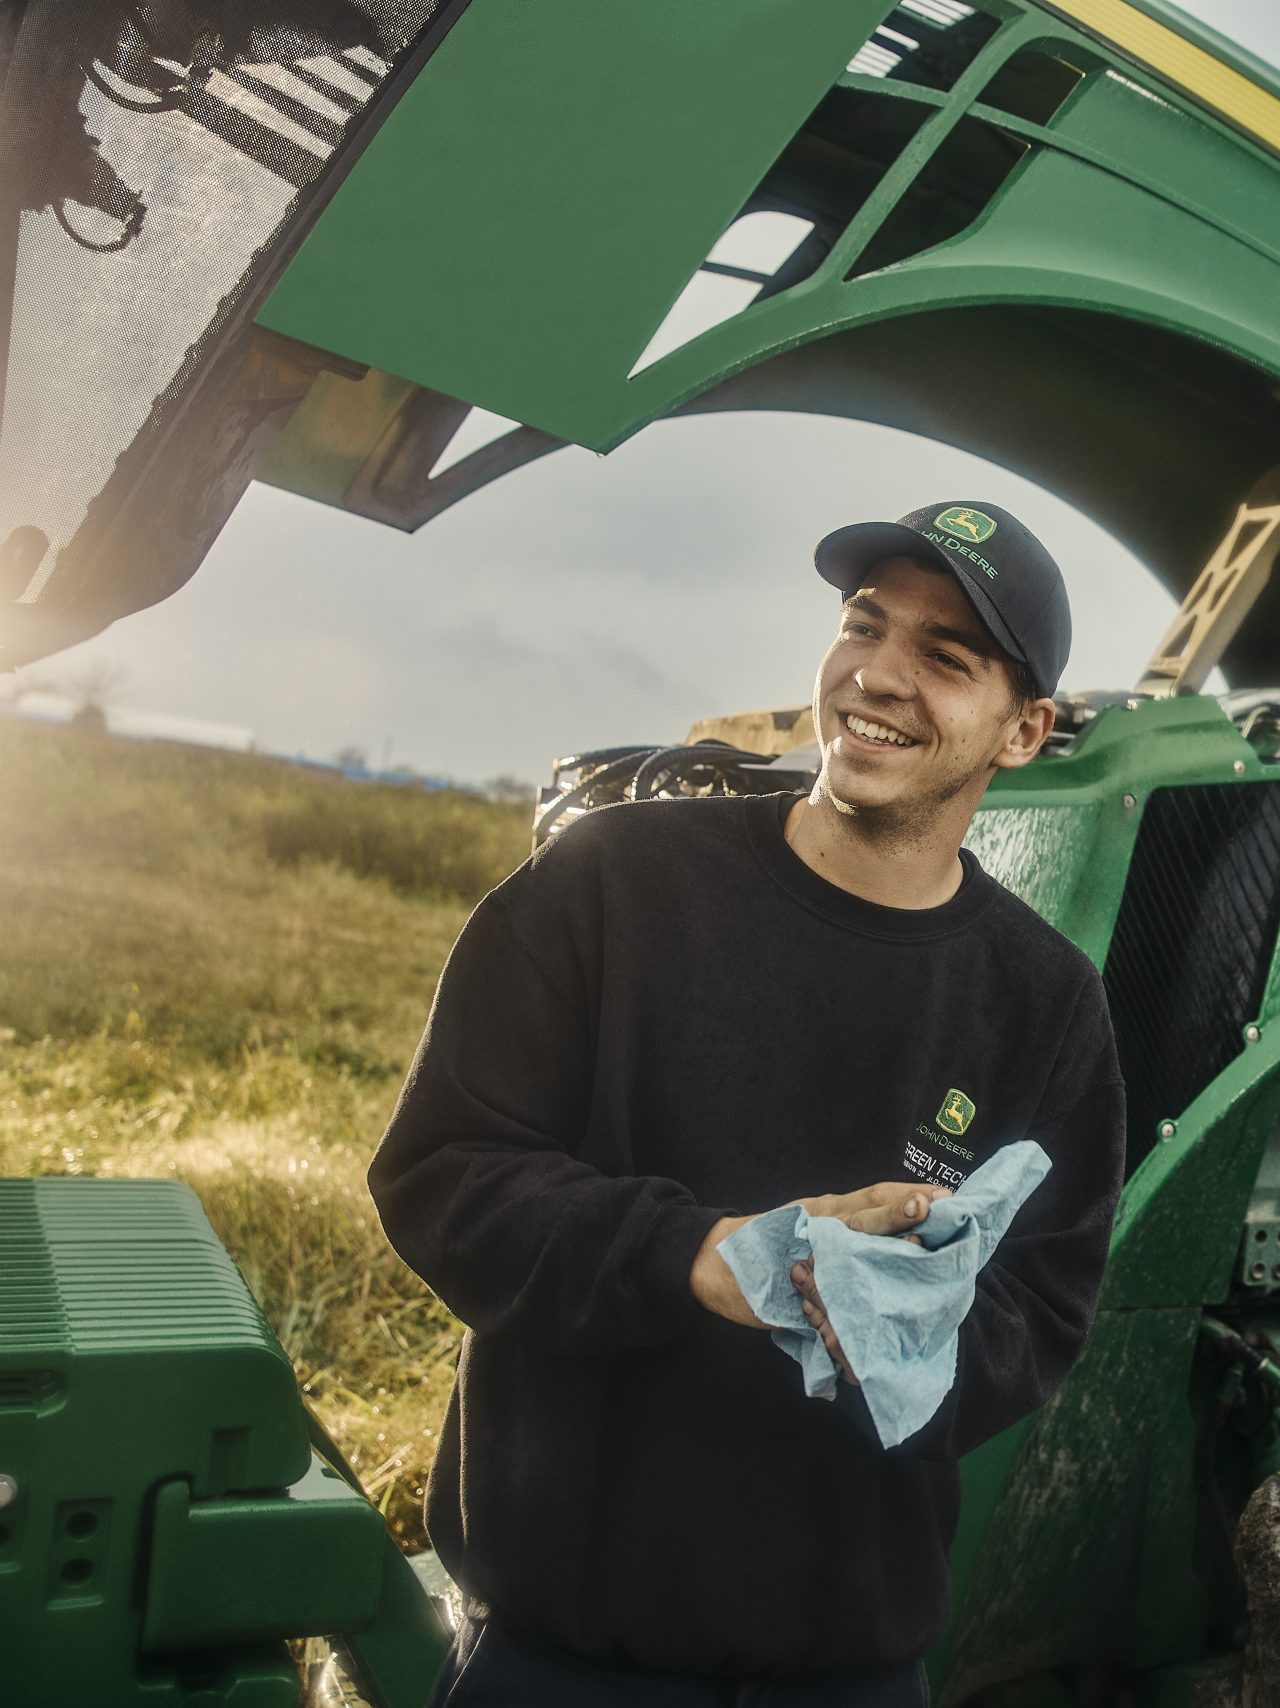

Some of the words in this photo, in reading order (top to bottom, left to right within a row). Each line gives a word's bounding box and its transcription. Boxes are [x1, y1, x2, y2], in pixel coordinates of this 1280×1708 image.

[918, 530, 945, 543] HN
[944, 537, 998, 580] DEERE
[915, 1122, 941, 1144] JOHN
[938, 1134, 976, 1161] DEERE
